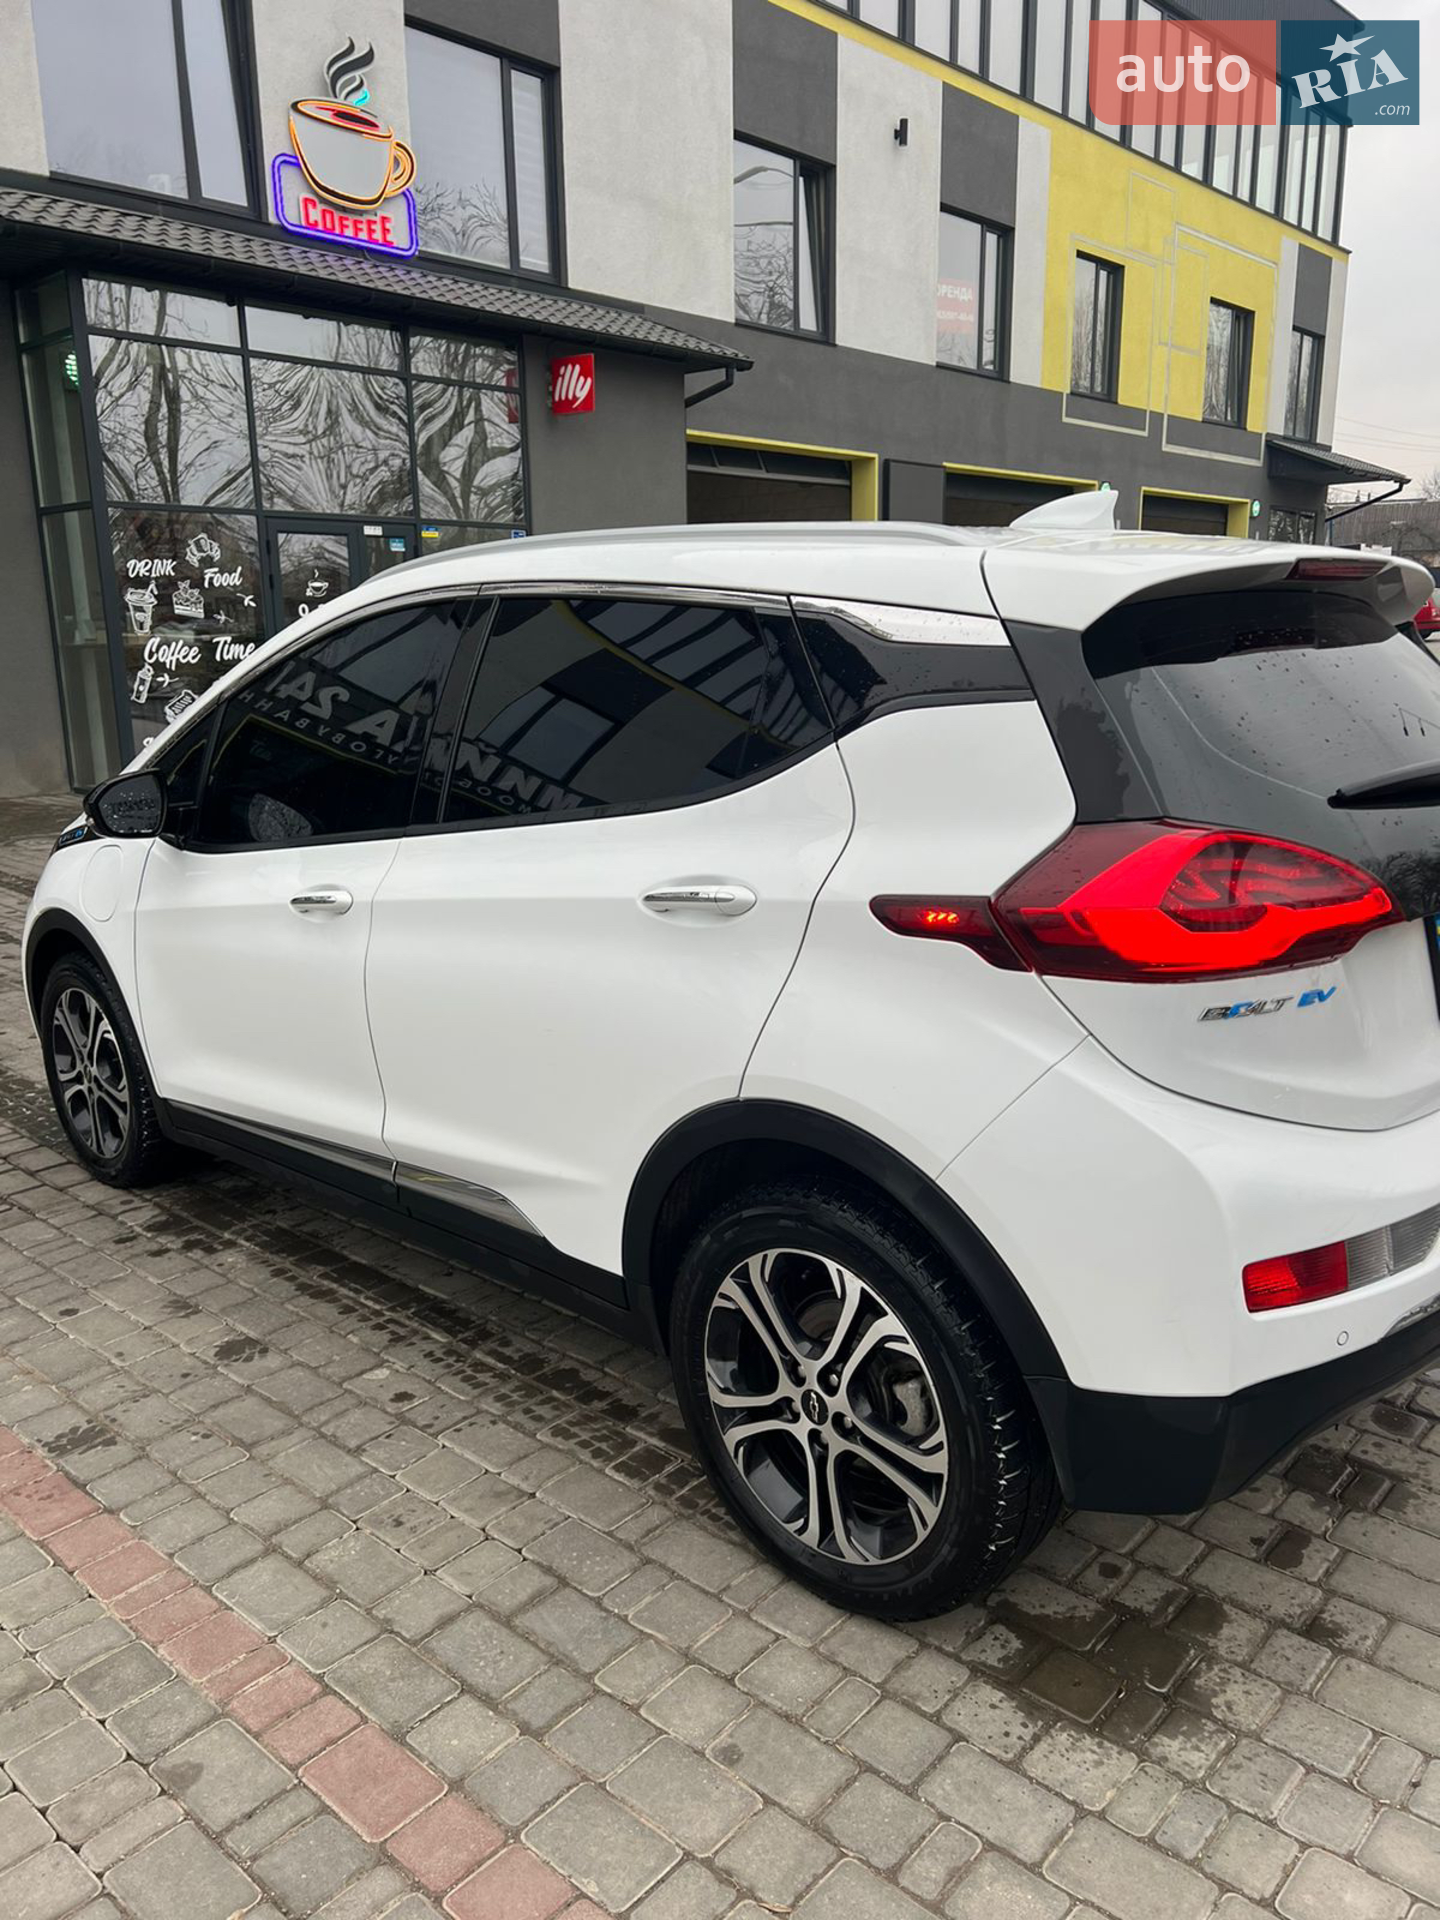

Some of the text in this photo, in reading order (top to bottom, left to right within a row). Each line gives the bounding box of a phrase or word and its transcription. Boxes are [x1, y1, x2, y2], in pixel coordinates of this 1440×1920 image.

[300, 196, 395, 247] COFFEE
[554, 363, 592, 409] illy
[126, 558, 177, 578] DRINK
[203, 565, 243, 588] Food
[143, 636, 256, 671] Coffee Time
[1297, 986, 1337, 1008] EV
